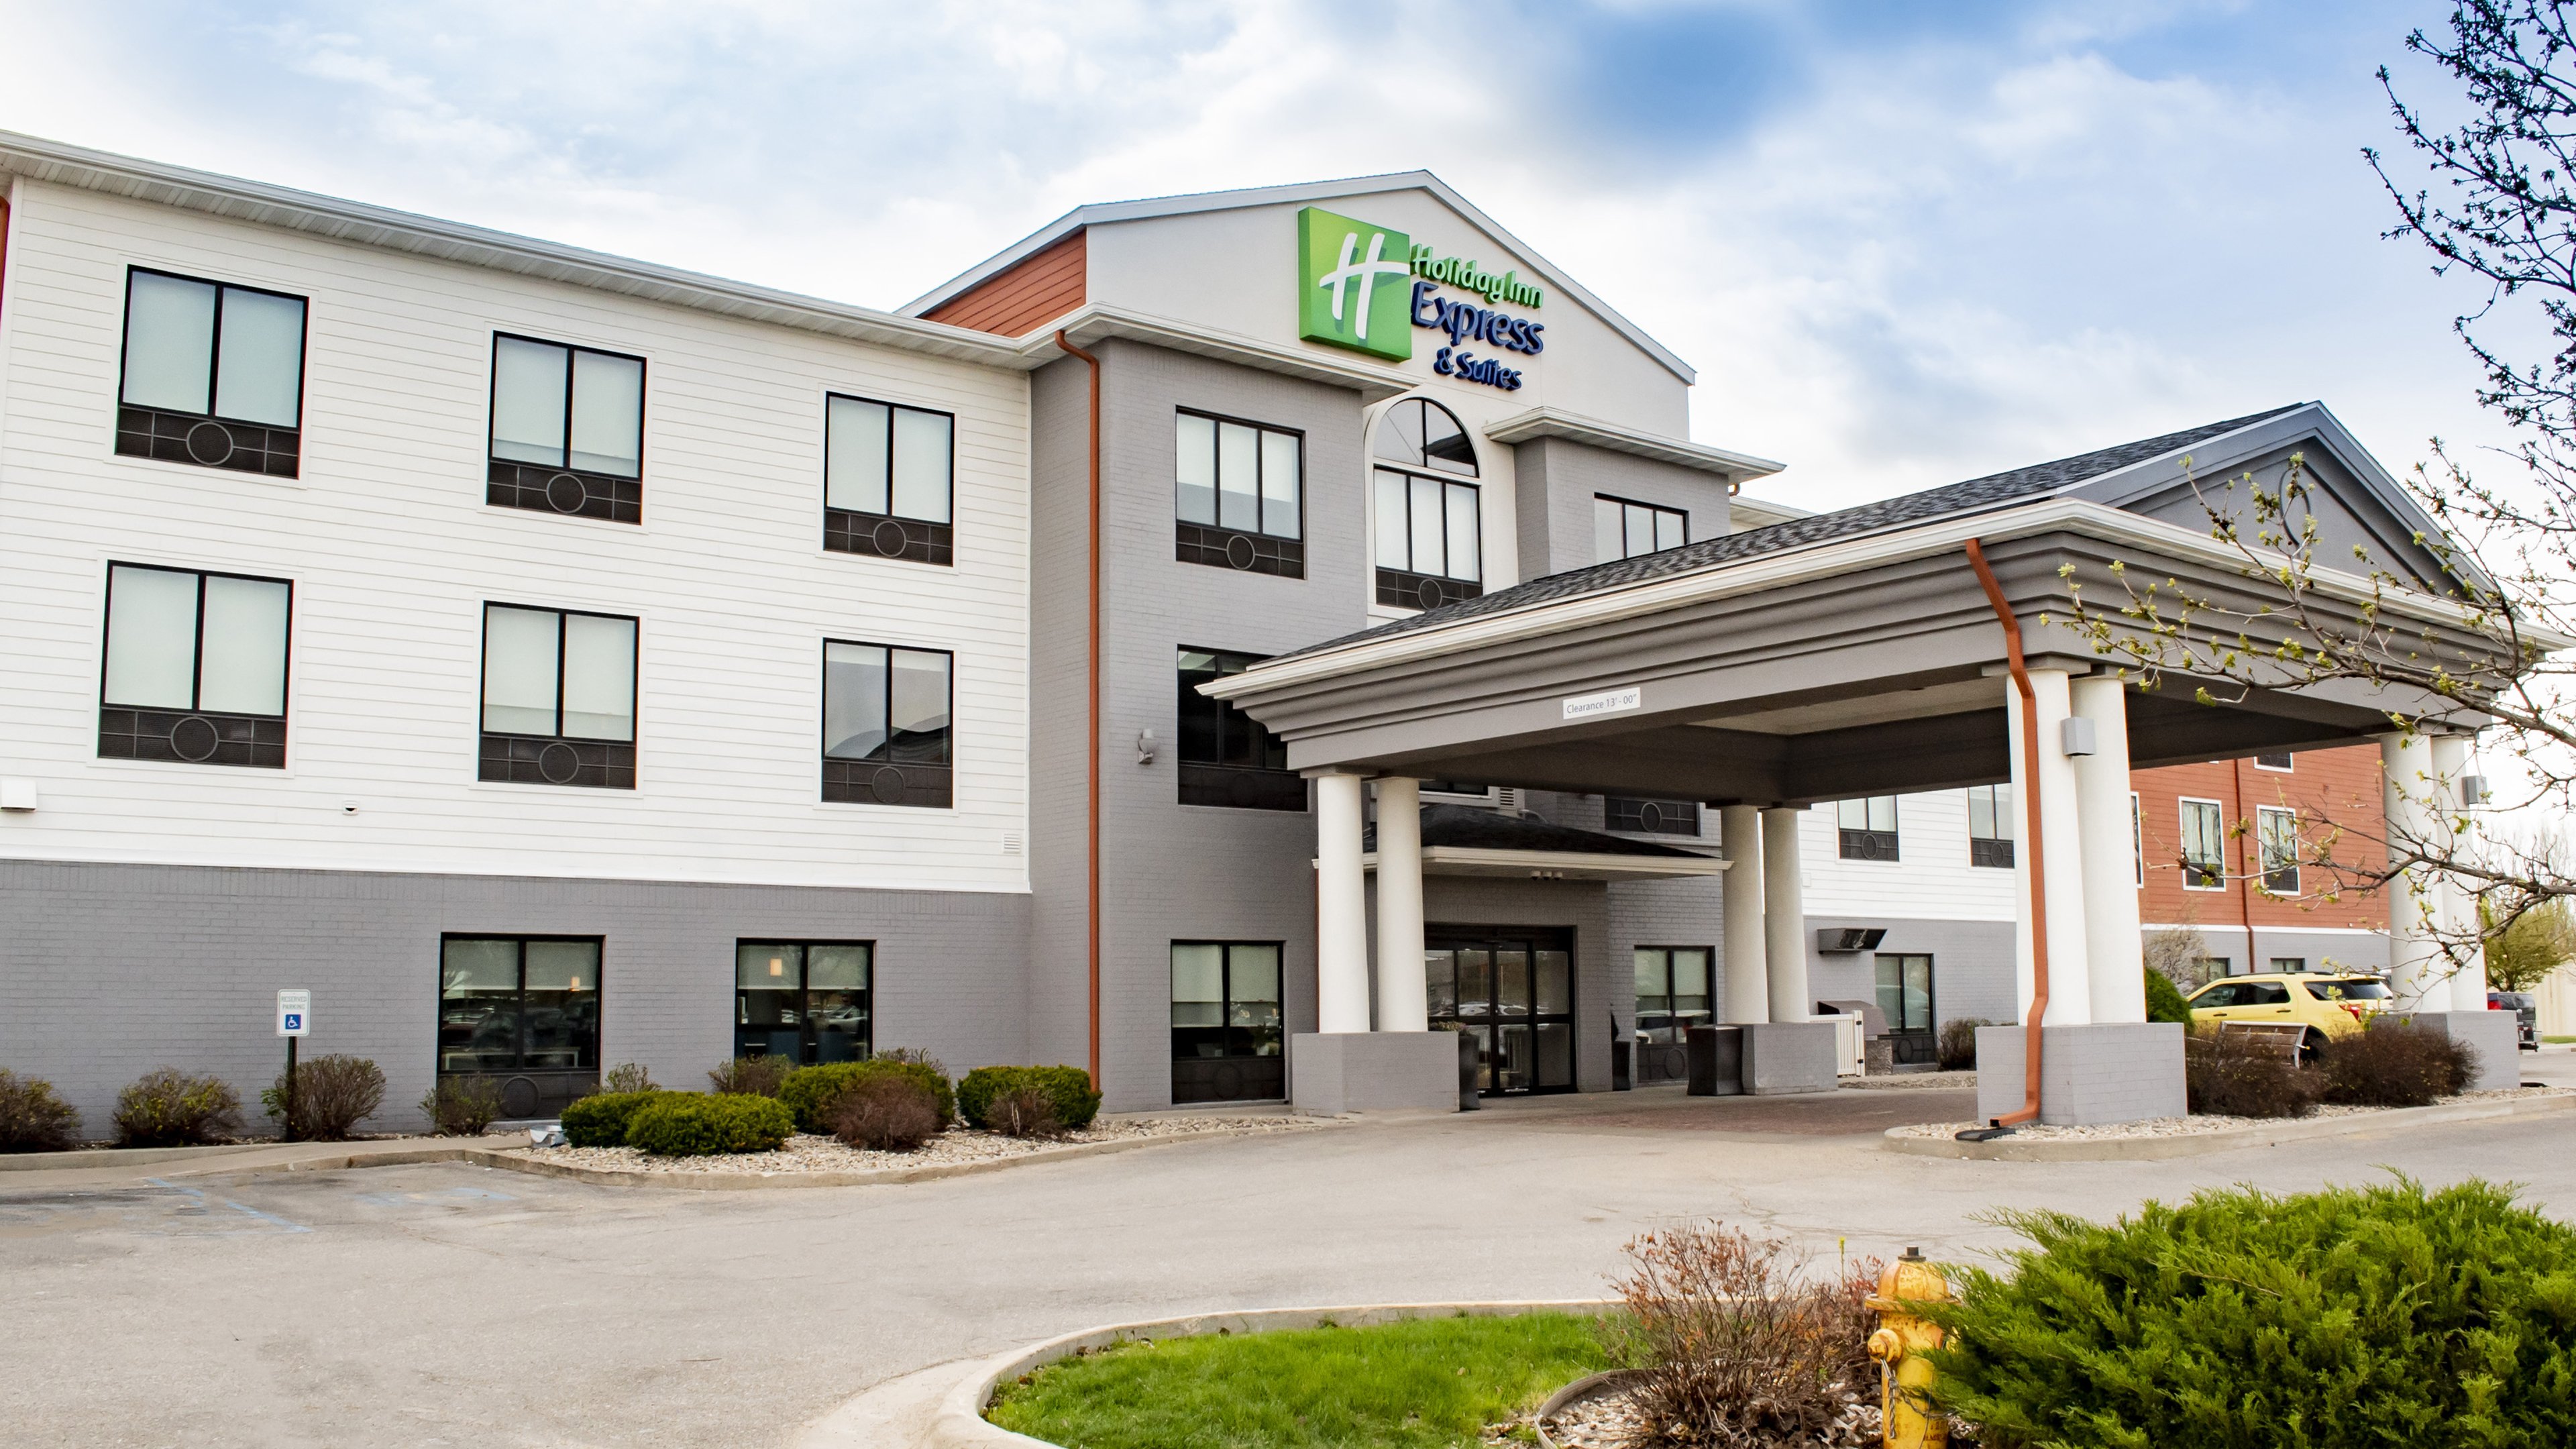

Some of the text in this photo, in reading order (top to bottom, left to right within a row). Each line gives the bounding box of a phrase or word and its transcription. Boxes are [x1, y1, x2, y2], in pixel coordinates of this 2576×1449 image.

[1410, 243, 1544, 309] Holiday Inn
[1411, 280, 1545, 355] Express
[1434, 346, 1522, 390] & Suites
[1566, 701, 1604, 714] Clearance
